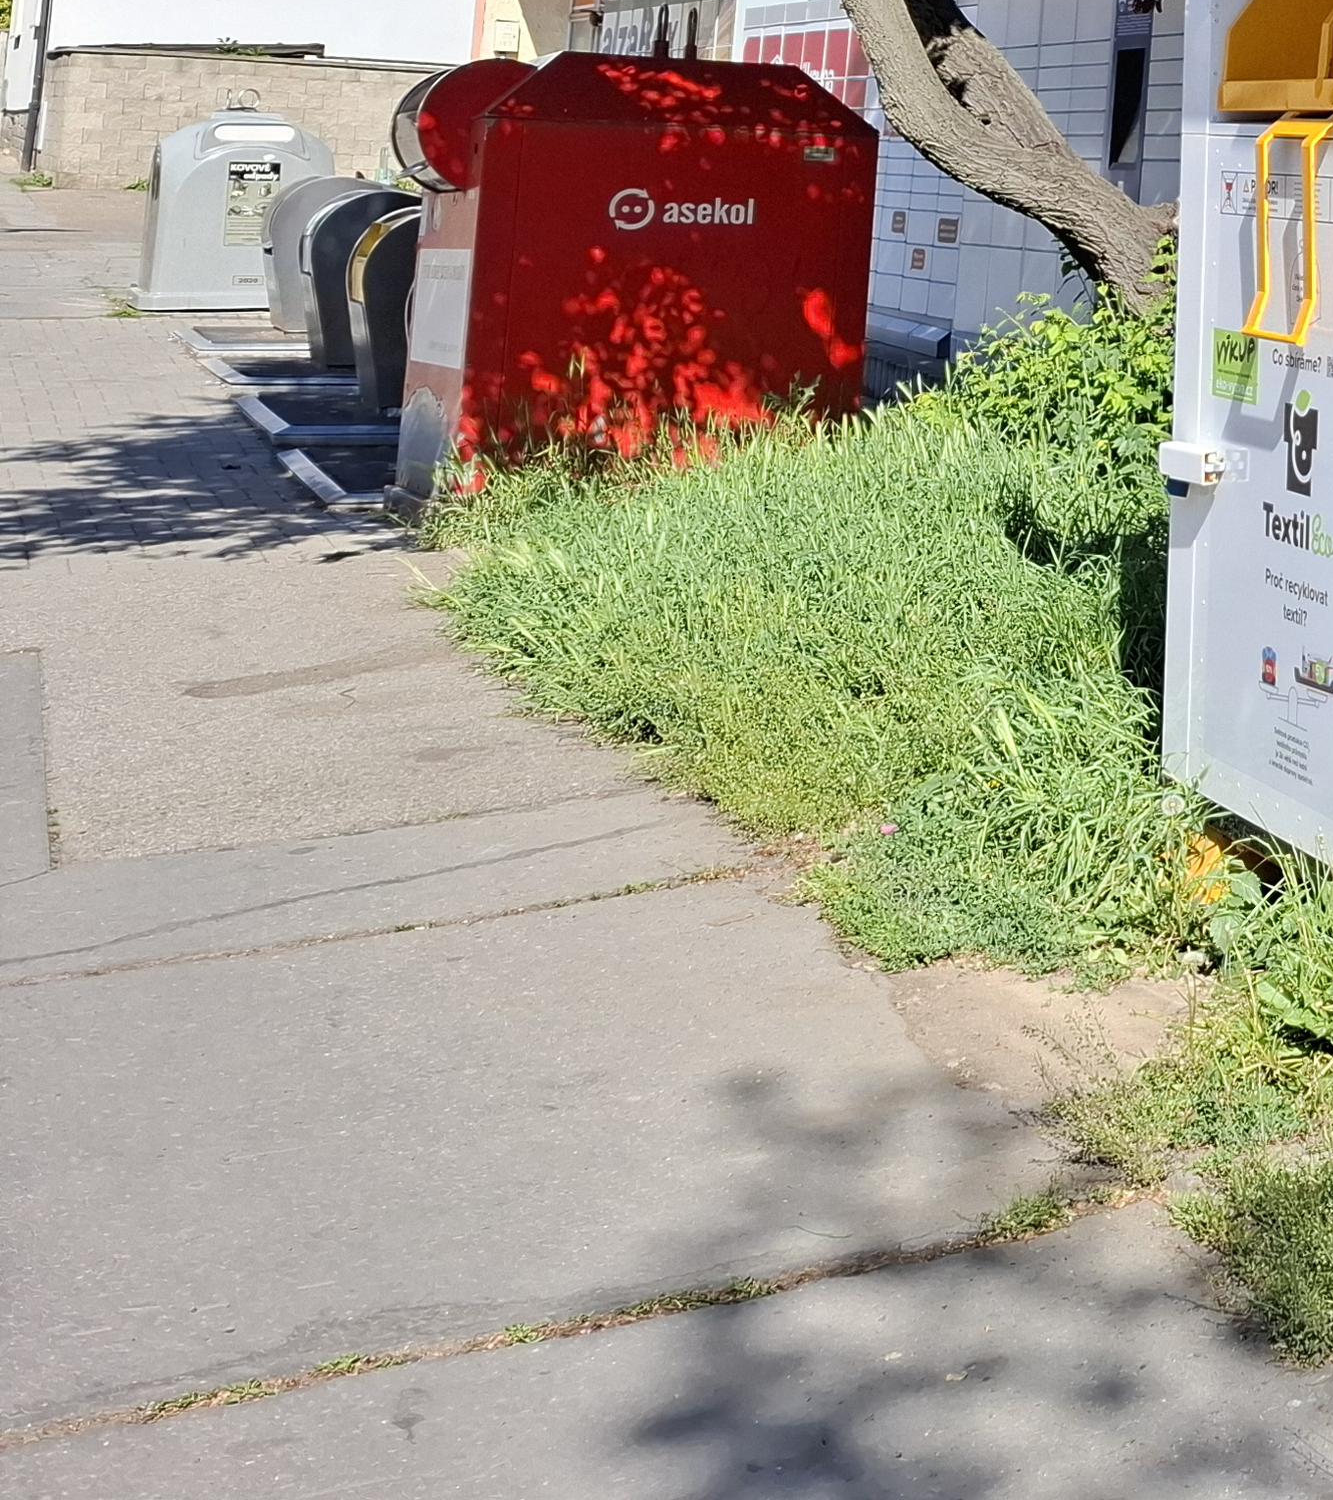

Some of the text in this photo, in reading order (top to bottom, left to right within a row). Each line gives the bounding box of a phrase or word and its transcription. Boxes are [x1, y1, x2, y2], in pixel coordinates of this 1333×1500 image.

[662, 197, 755, 227] asekol
[1272, 348, 1322, 373] Co sbíráme?
[1265, 567, 1328, 607] Proč recyklovat
[1283, 603, 1308, 627] textil?
